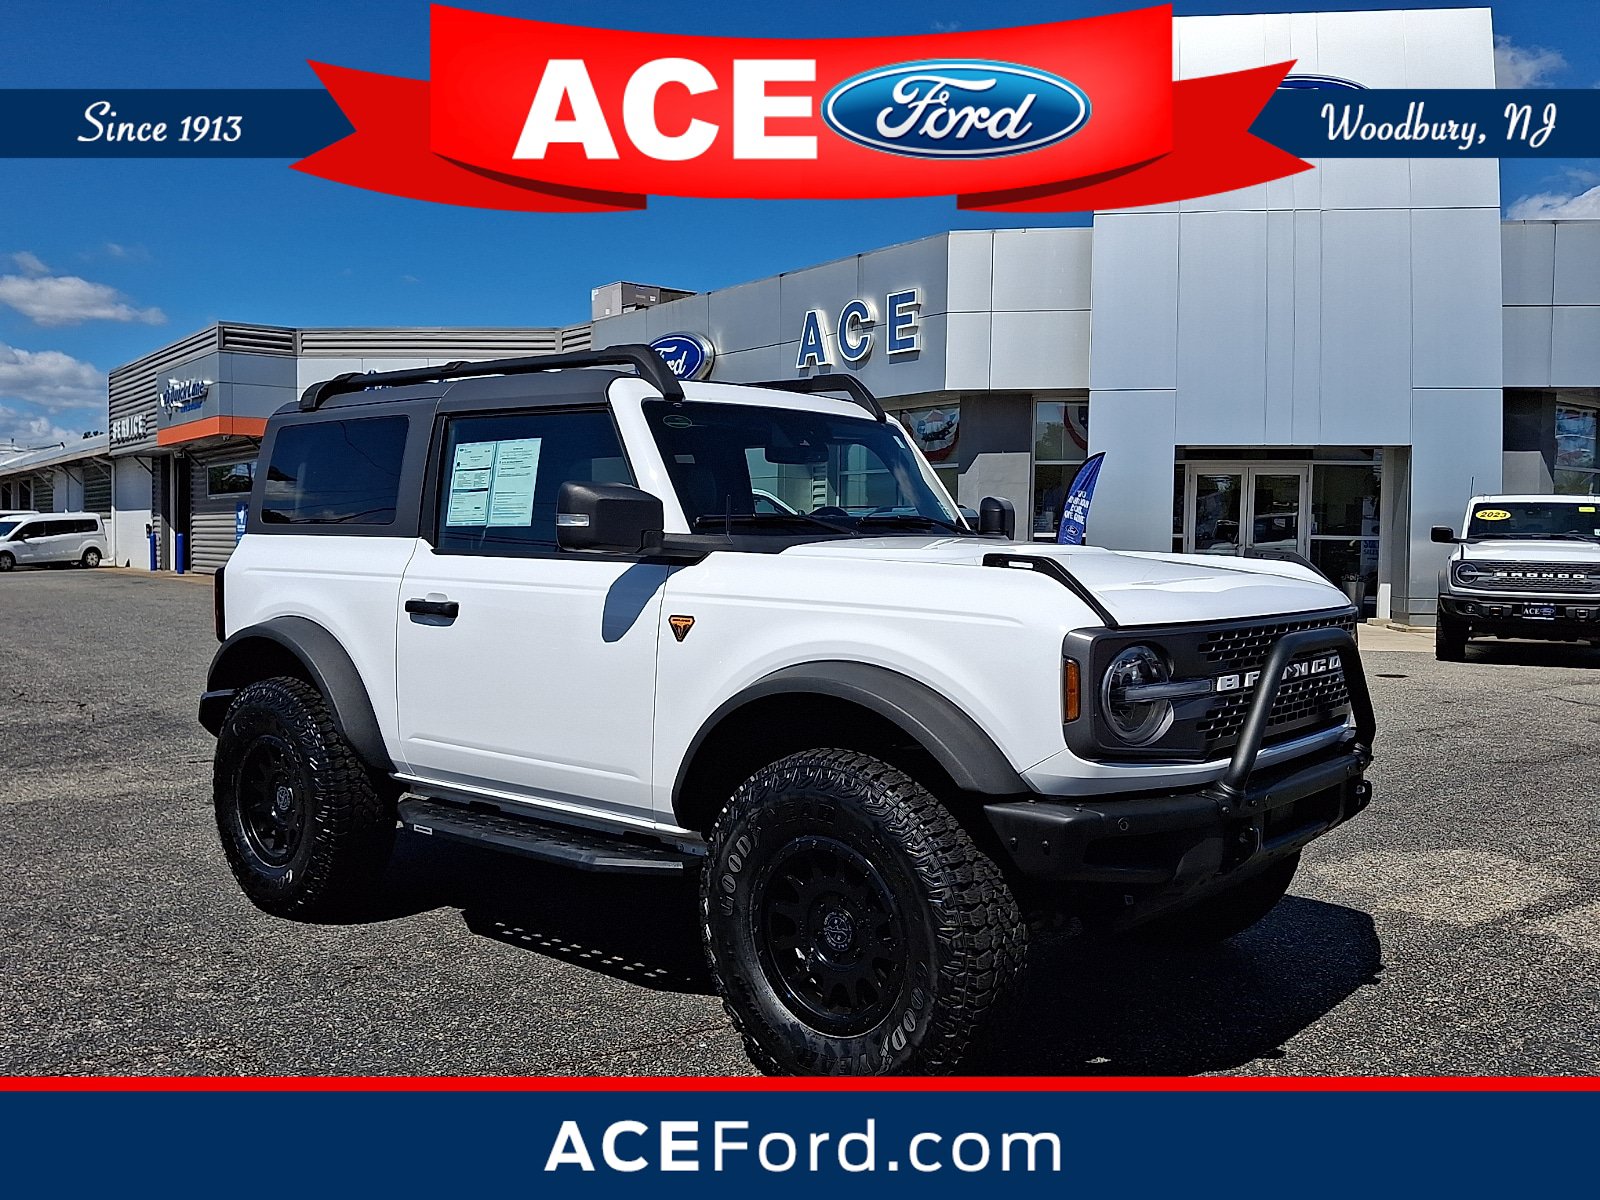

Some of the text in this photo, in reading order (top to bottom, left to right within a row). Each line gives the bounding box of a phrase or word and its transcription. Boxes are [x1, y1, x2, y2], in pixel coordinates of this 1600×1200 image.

[795, 287, 922, 369] ACE
[112, 414, 144, 440] SERVICE
[1523, 606, 1540, 615] ACE
[1216, 655, 1342, 692] BRNCO
